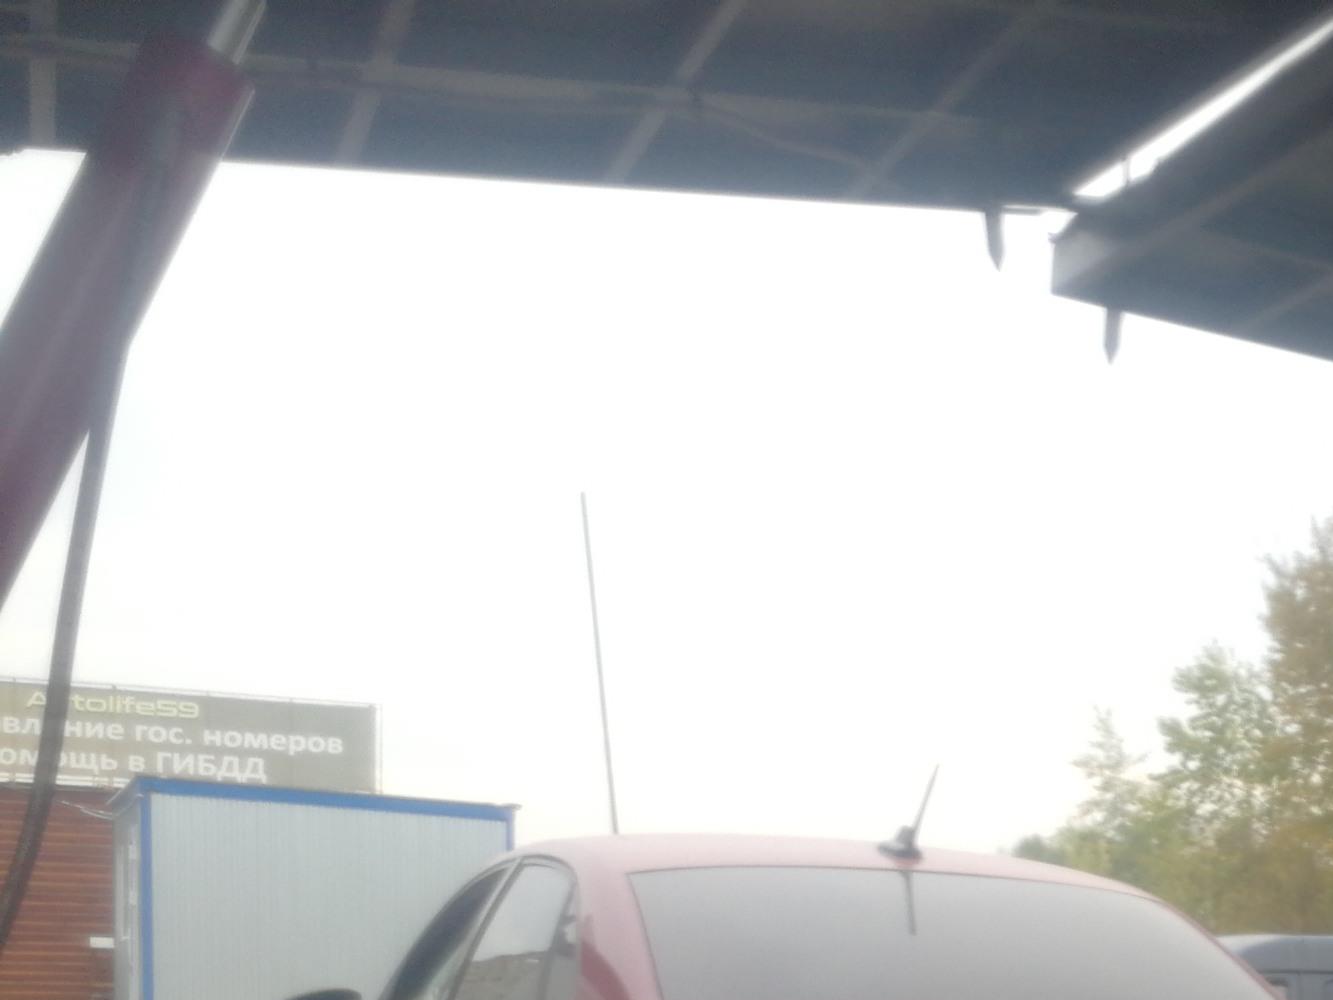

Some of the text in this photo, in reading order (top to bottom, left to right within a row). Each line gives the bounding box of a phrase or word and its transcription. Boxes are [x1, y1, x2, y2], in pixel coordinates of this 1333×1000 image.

[26, 690, 200, 719] Atolife59
[2, 716, 344, 756] влние гос. номеров
[155, 752, 268, 784] ГИБДД
